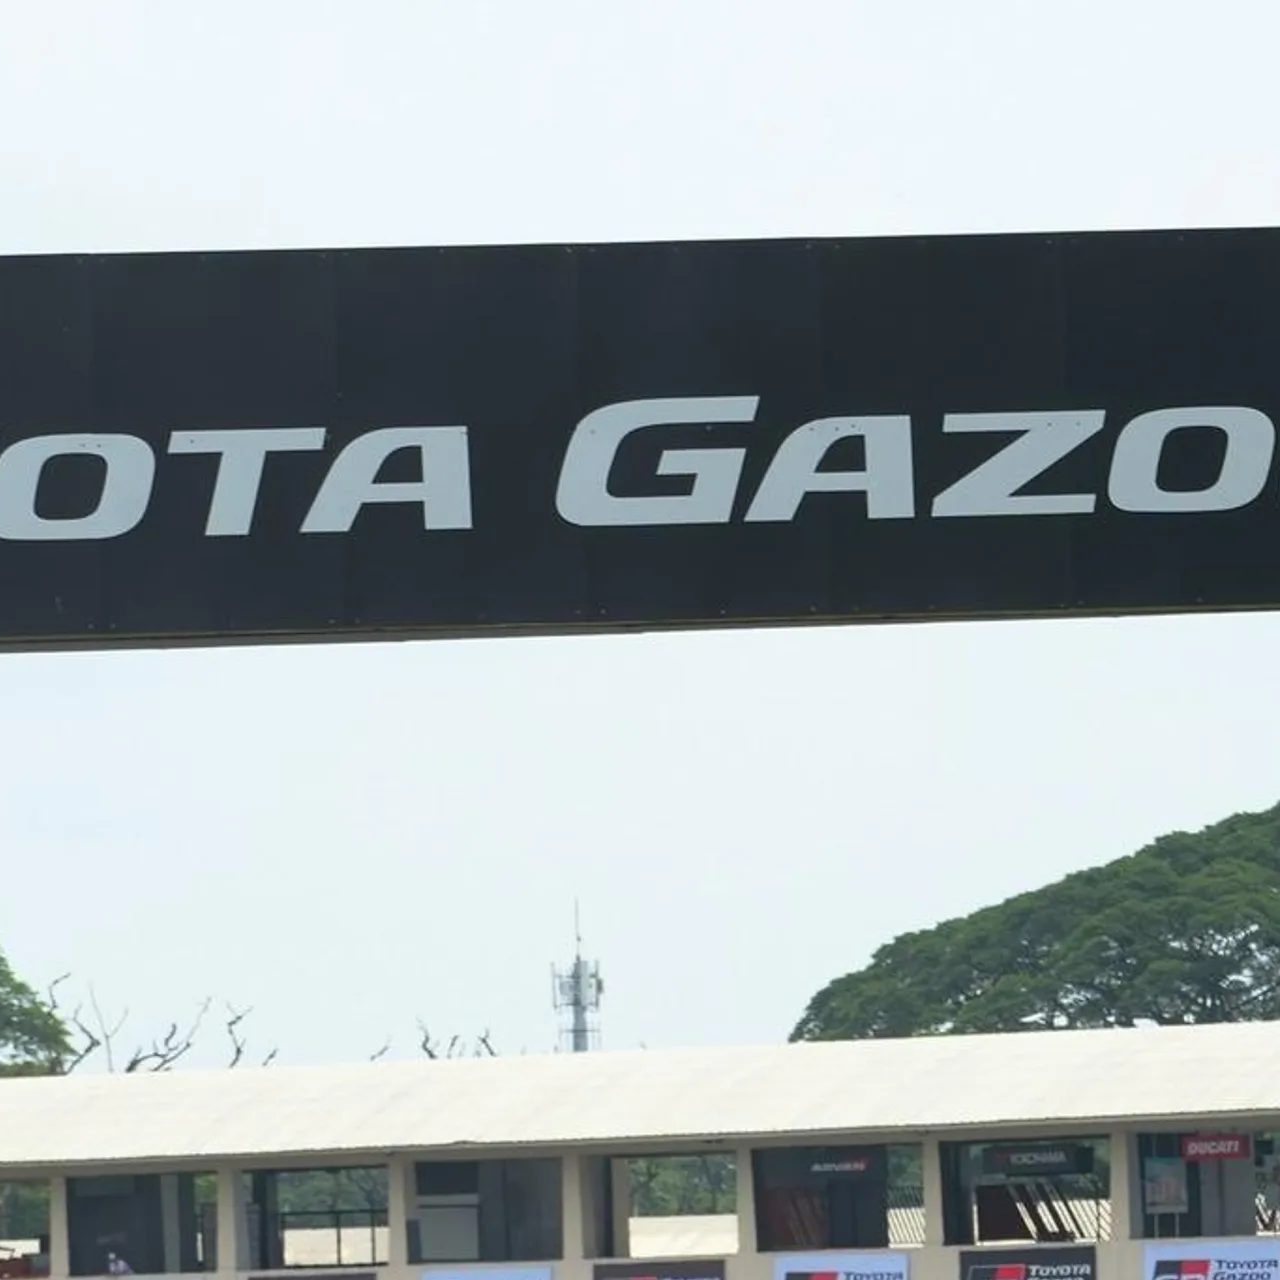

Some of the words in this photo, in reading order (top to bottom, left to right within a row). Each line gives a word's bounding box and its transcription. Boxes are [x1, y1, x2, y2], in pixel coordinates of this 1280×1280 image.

[1187, 1141, 1240, 1155] DUCATI
[1216, 1260, 1278, 1269] TOYOTA
[1029, 1265, 1091, 1275] TOYOTA
